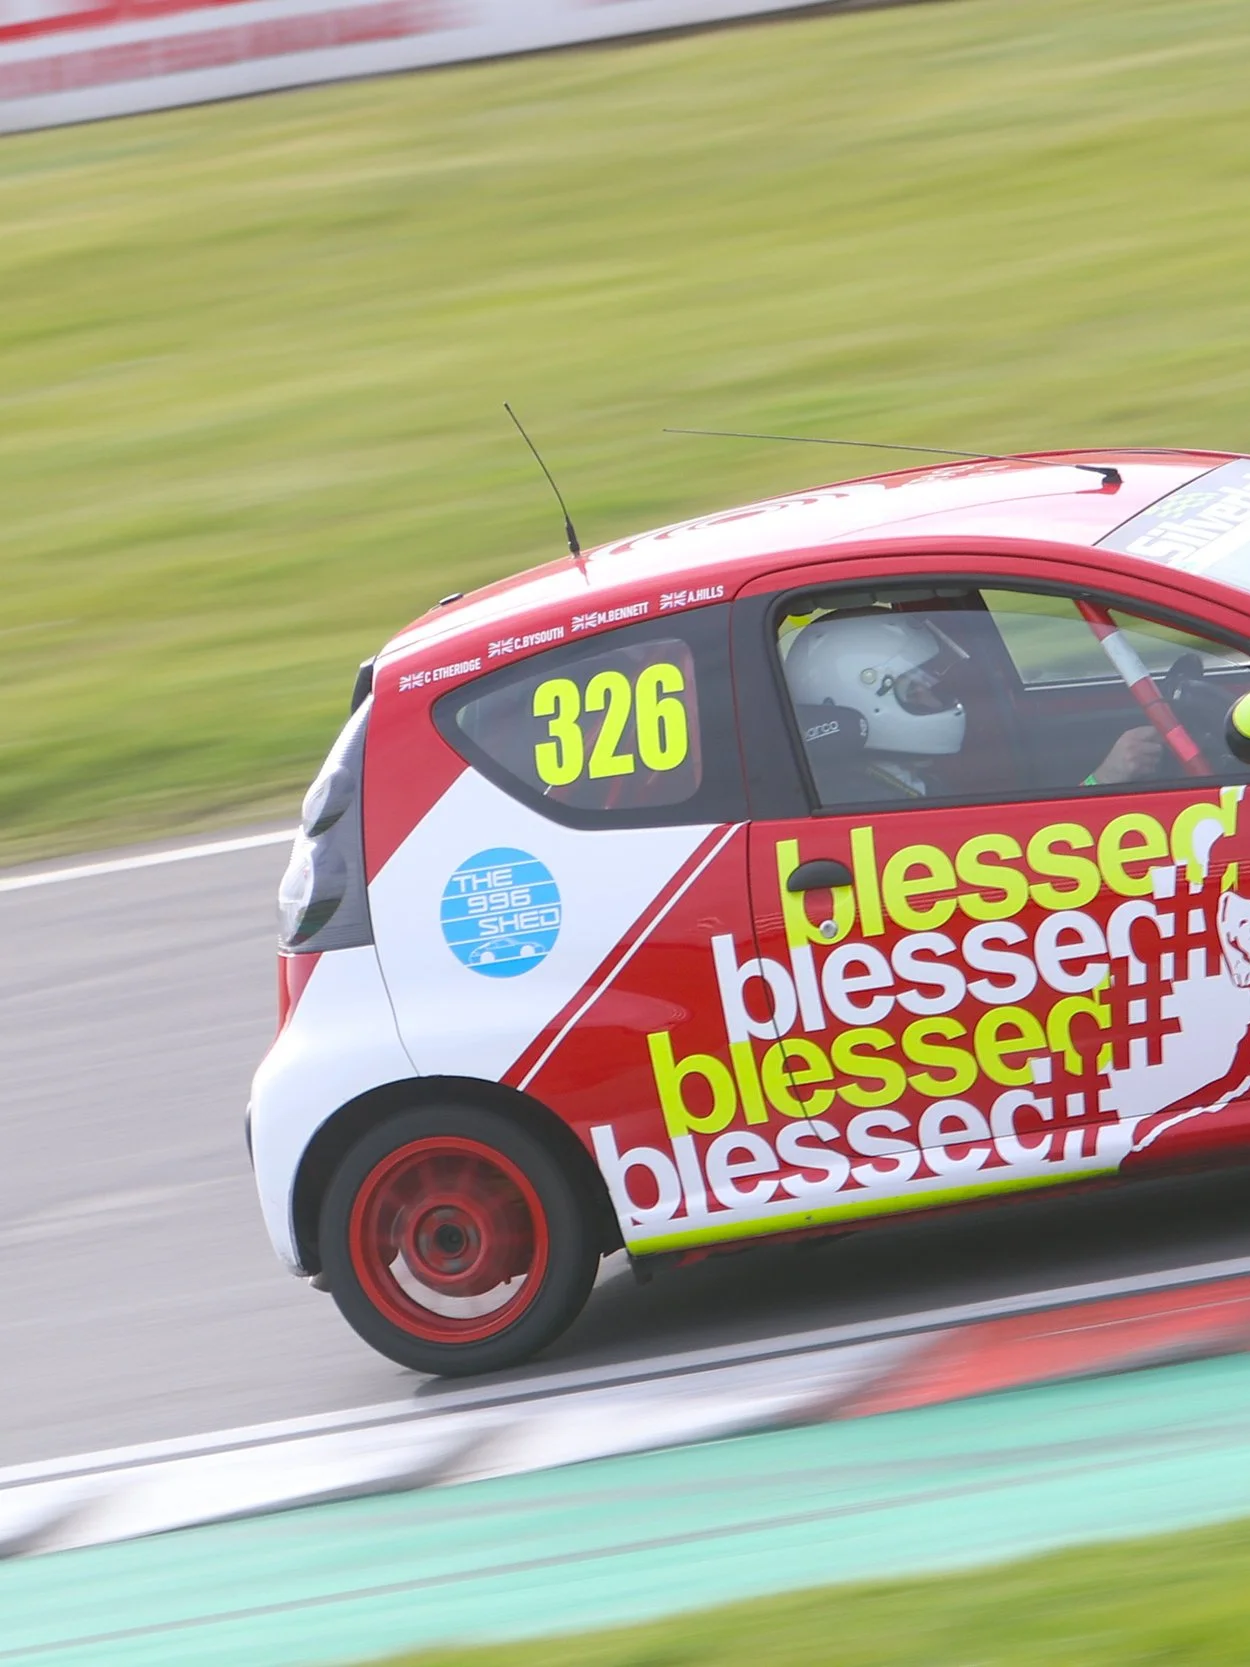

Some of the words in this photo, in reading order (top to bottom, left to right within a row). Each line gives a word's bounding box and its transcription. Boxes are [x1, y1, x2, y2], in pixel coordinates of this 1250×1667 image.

[687, 585, 724, 603] A.HILLS
[597, 601, 649, 625] M.BENNETT
[514, 626, 564, 650] C.BYSOUTH
[433, 657, 481, 681] ETHERIDGE
[533, 663, 689, 786] 326
[804, 720, 839, 738] arco
[452, 868, 513, 893] THE
[467, 888, 531, 914] 996
[478, 907, 560, 936] SHED
